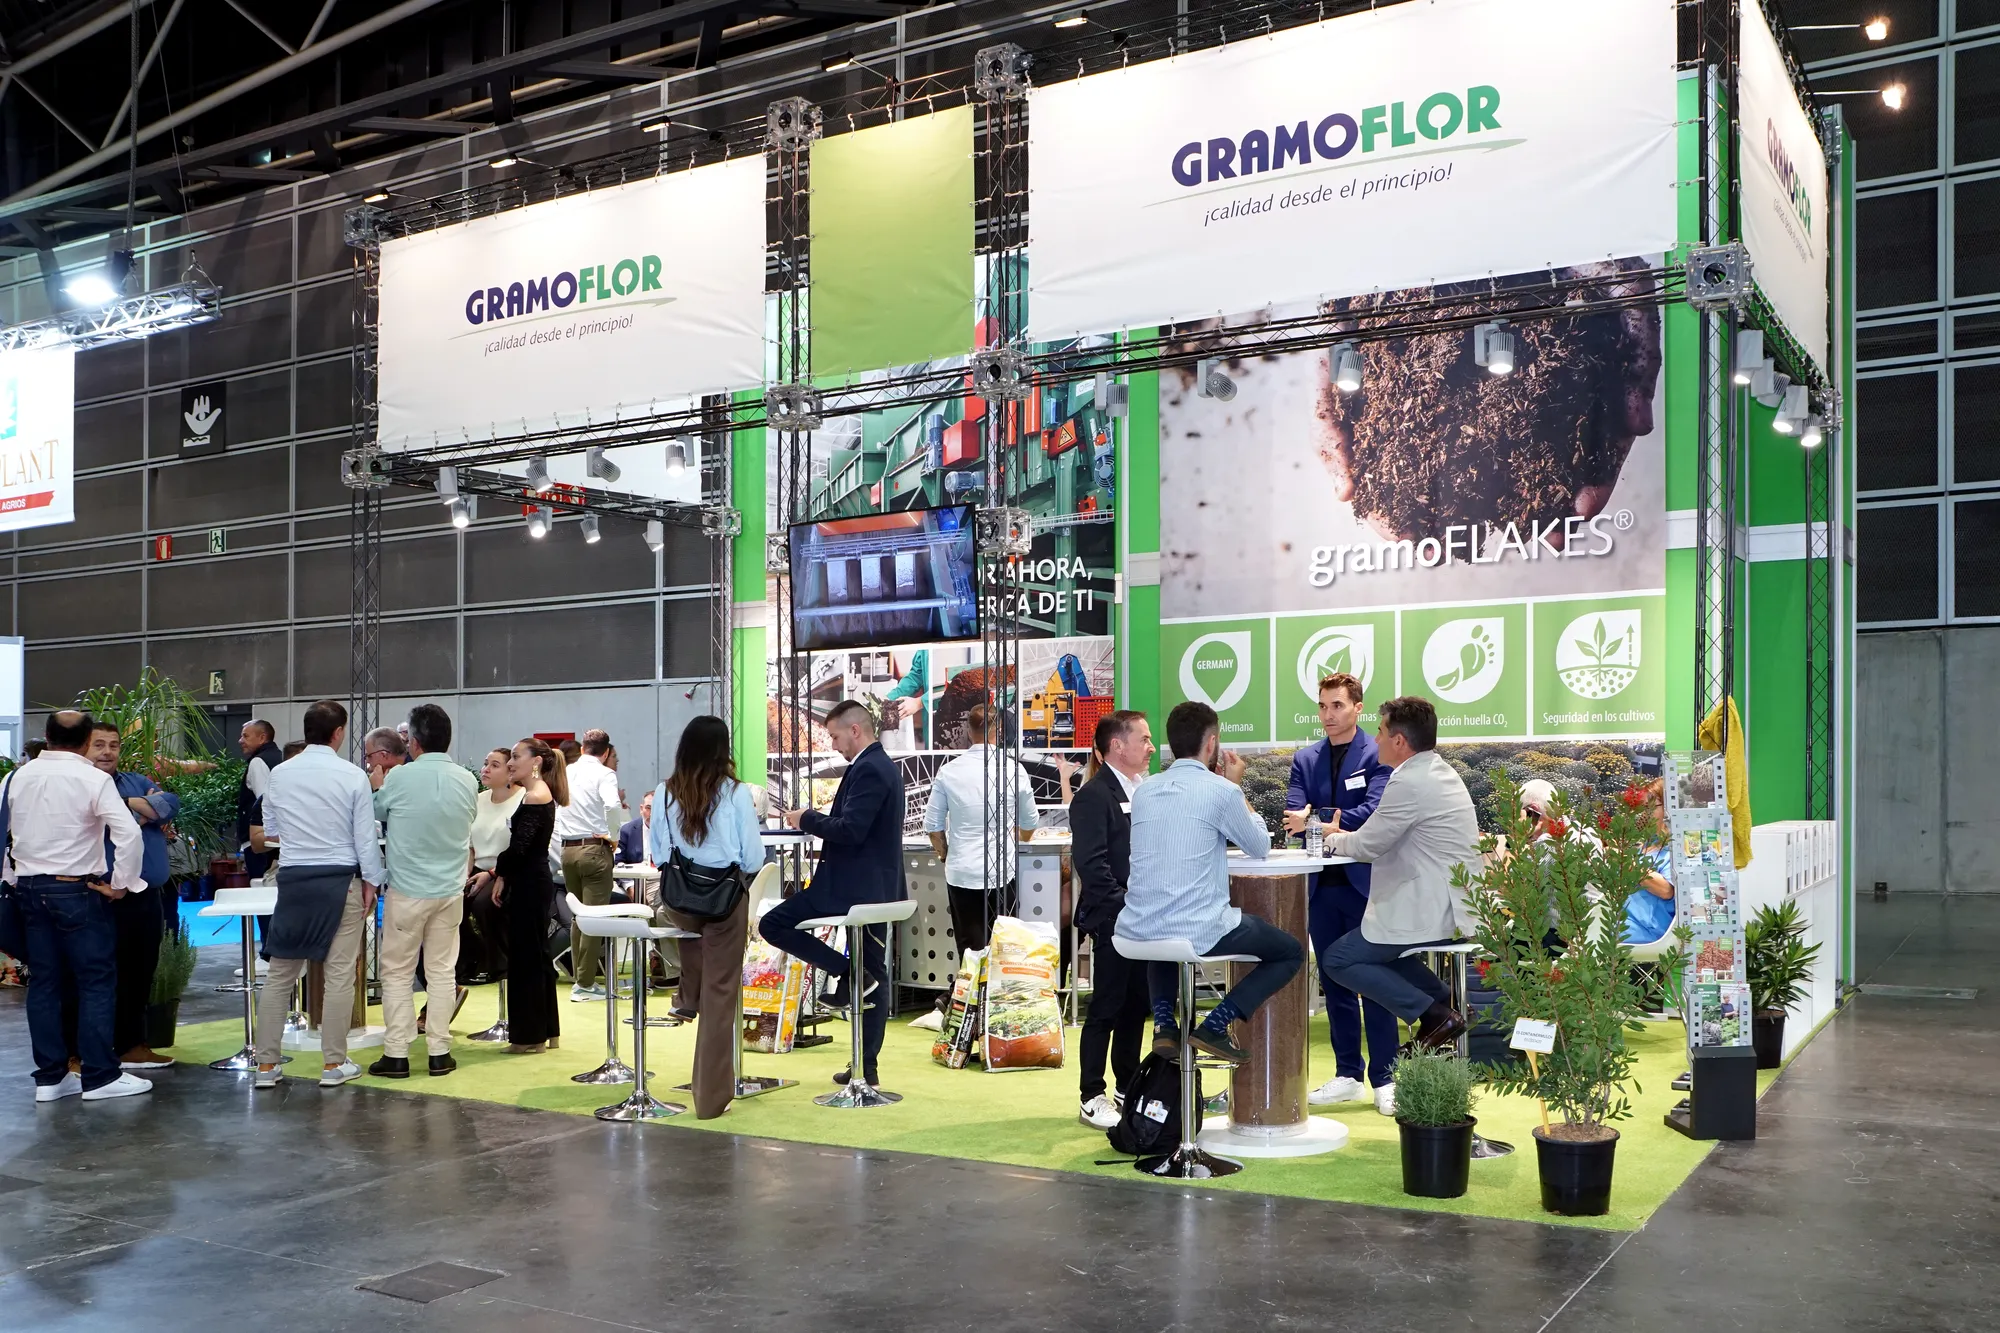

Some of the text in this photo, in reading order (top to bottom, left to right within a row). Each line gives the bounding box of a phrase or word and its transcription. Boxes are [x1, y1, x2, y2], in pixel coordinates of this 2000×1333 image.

[1171, 85, 1502, 187] GRAMOFLOR
[1204, 162, 1453, 227] ¡calidad desde el principio!
[465, 255, 663, 325] GRAMOFLOR
[484, 313, 634, 357] ¡calidad desde el principio!
[0, 439, 59, 487] LANT
[978, 588, 1093, 618] ERCA DE TI
[1196, 658, 1234, 670] GERMANY
[1294, 713, 1310, 724] Con
[1437, 714, 1462, 727] cción
[1463, 713, 1491, 726] huella
[1542, 709, 1655, 727] Seguridad en los cultivos
